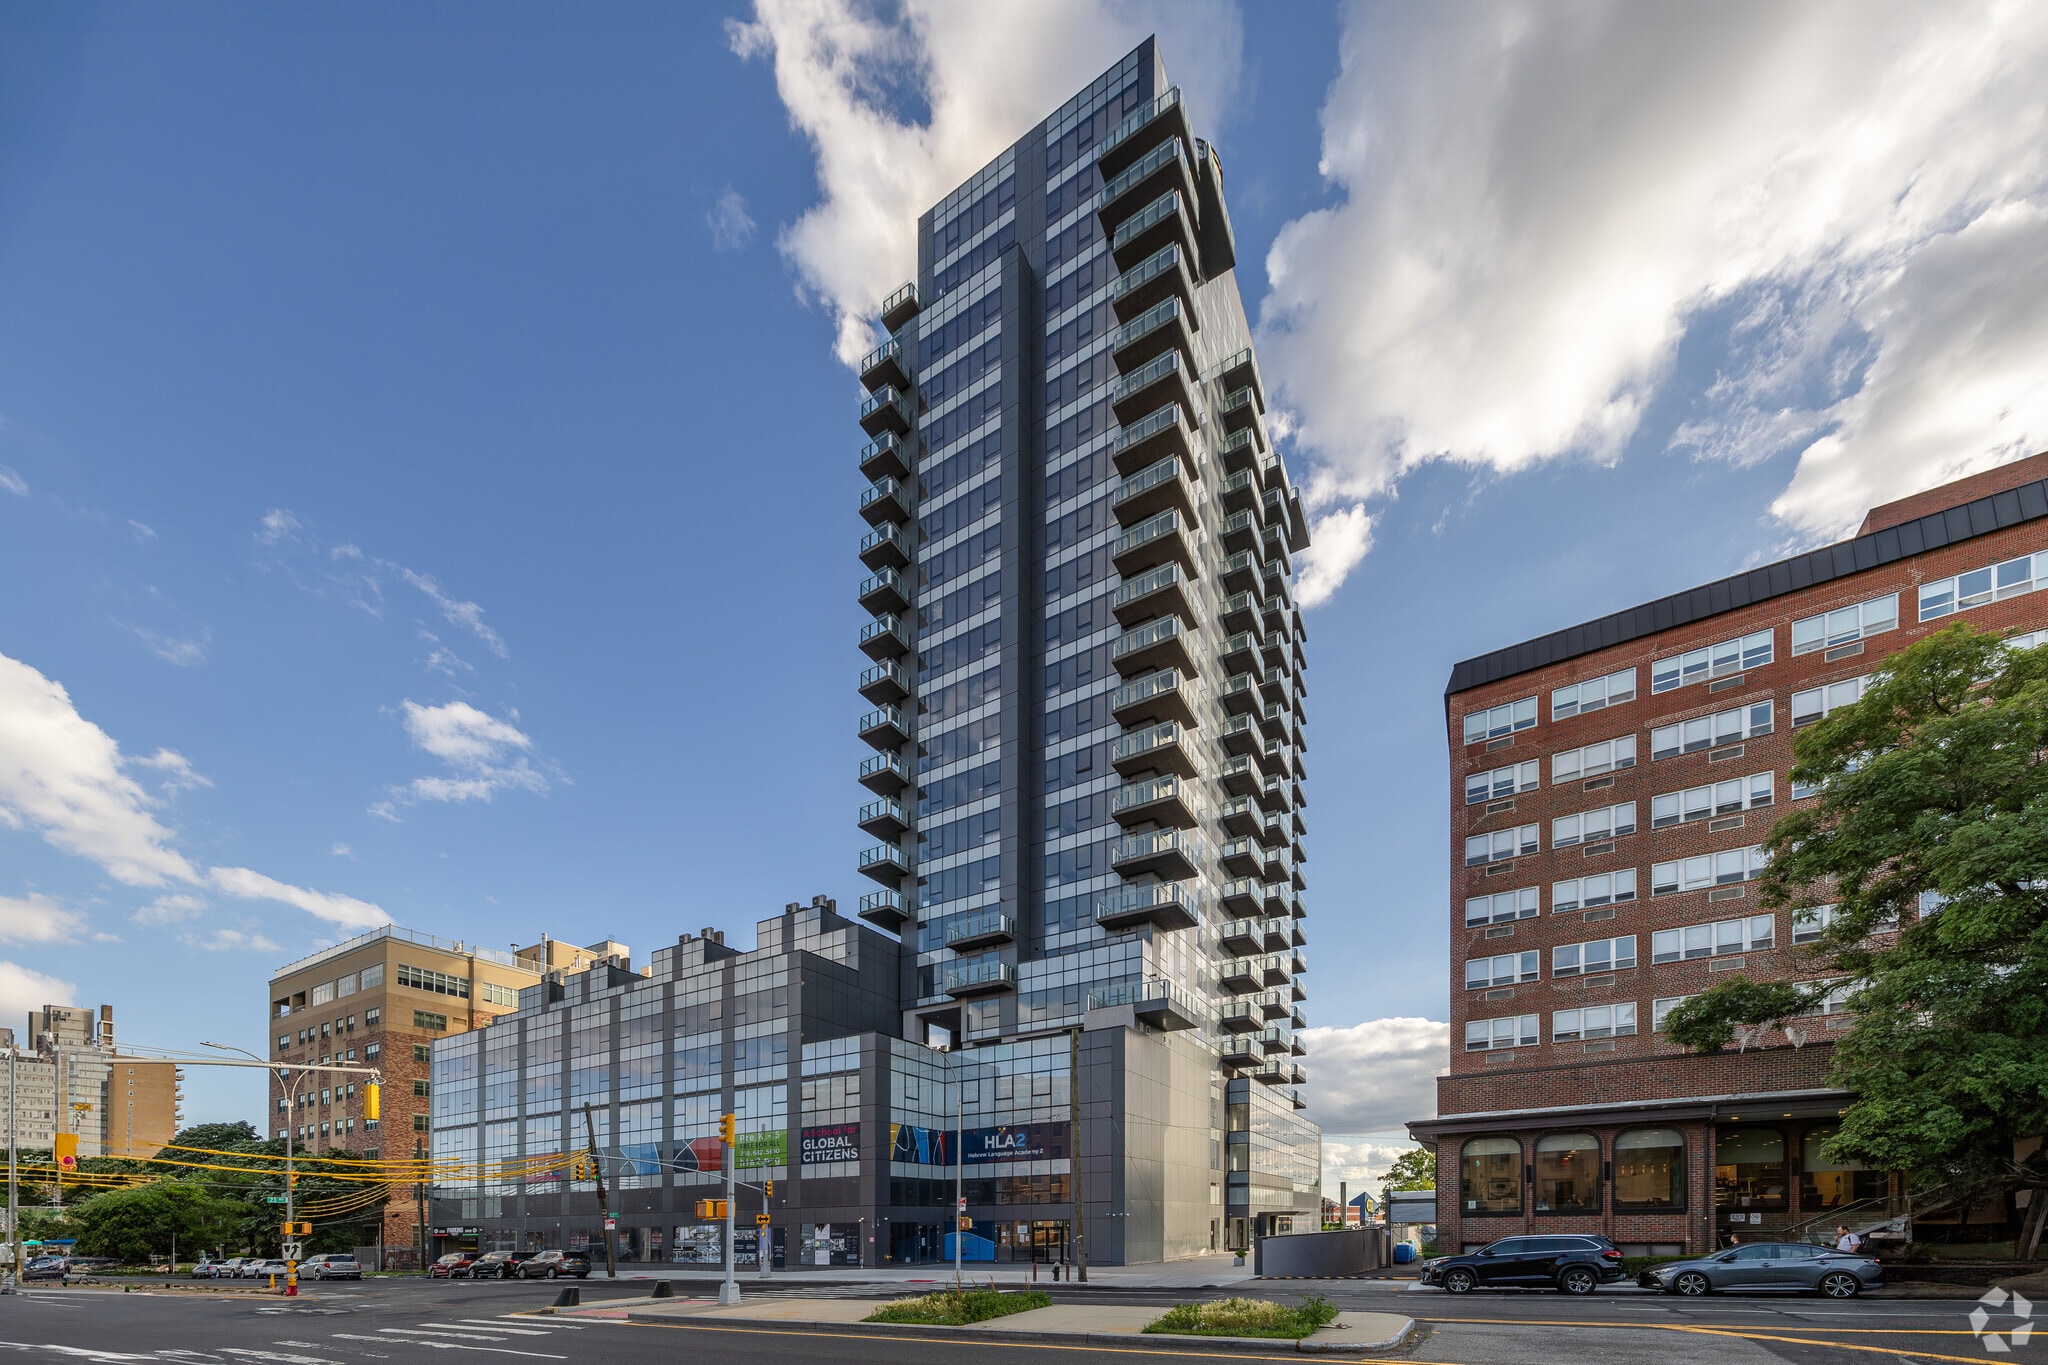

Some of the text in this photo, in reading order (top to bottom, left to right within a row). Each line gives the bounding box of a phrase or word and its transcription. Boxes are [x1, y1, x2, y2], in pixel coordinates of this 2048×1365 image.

[775, 1131, 780, 1139] 5
[803, 1129, 809, 1138] A
[811, 1126, 841, 1137] School
[802, 1135, 852, 1150] GLOBAL
[984, 1133, 1026, 1149] HLA2
[802, 1147, 859, 1162] CITIZENS
[1014, 1148, 1039, 1156] Academy
